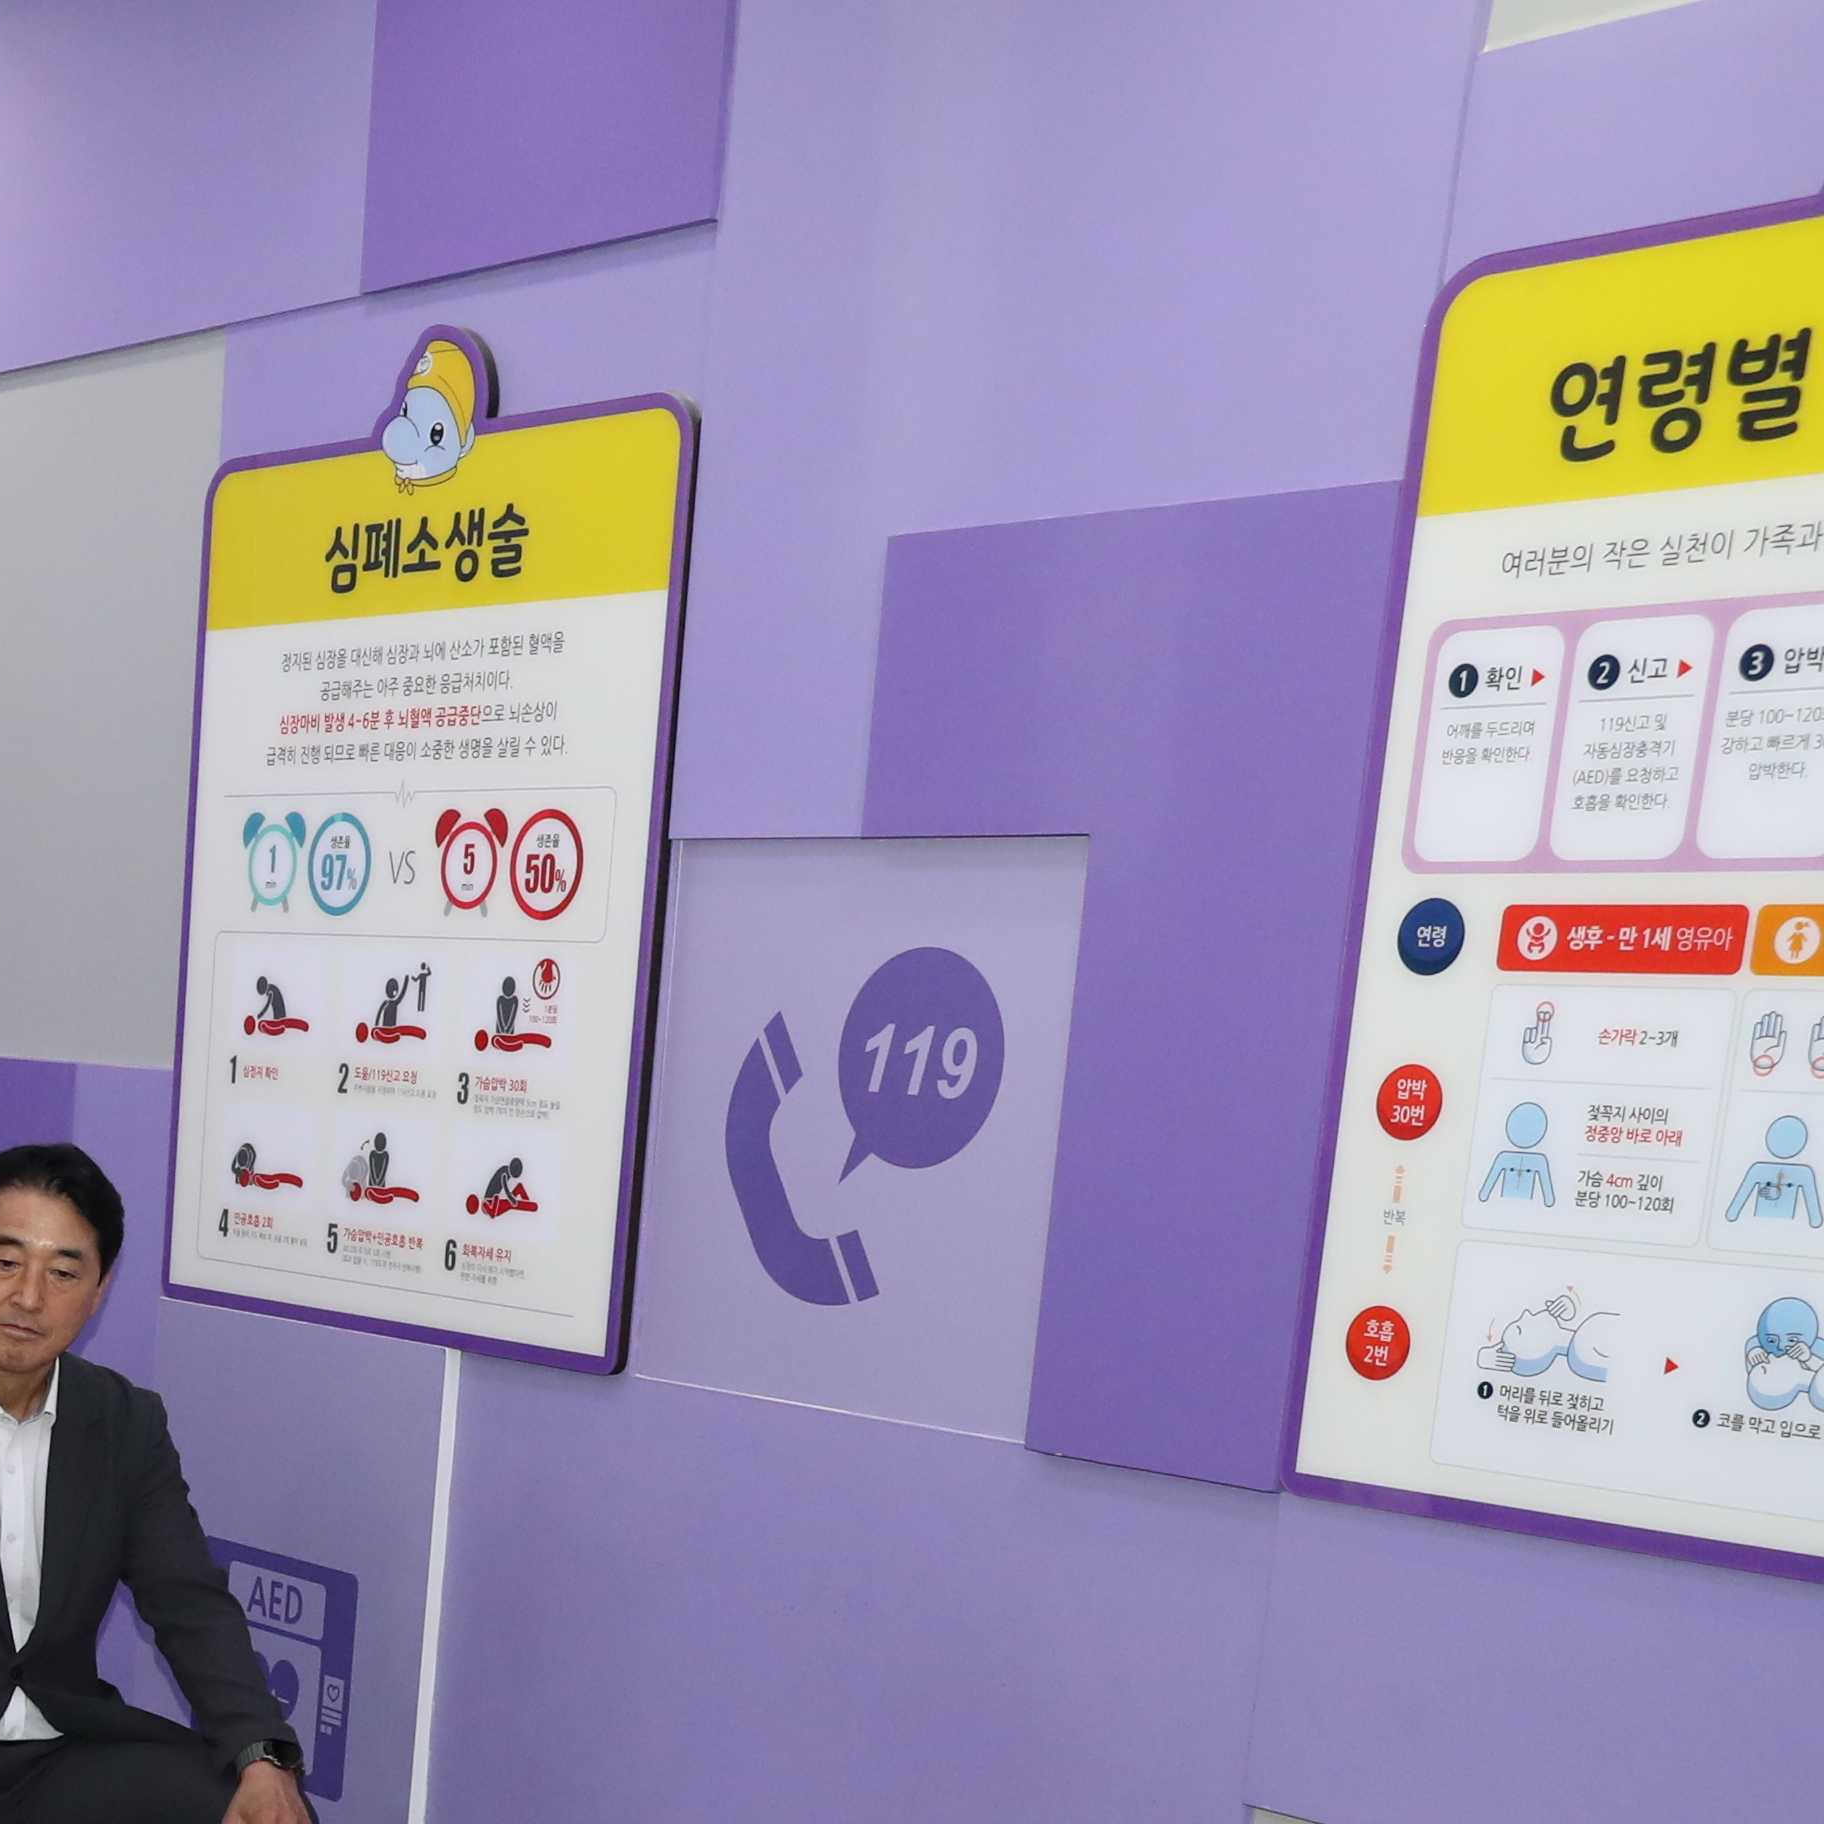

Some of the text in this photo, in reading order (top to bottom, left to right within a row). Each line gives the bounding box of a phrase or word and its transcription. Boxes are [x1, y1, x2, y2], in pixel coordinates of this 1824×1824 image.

[1550, 327, 1812, 462] 연령별
[325, 503, 529, 594] 심폐소생술
[1502, 520, 1824, 579] 여러분의 작은 실천이 가족과
[282, 631, 565, 672] 정지된 심장을 대신해 심장과 뇌에 산소가 포함된 혈액을
[1748, 651, 1765, 675] 3
[1485, 665, 1523, 691] 확인
[1596, 657, 1669, 684] 2 신고
[320, 669, 513, 701] 공급해주는 아주 중요한 응급처치이다.
[280, 700, 558, 735] 심장마비 발생 4~6분 후 뇌혈액 공급중단으로 뇌손상이
[1446, 720, 1535, 740] 어깨를 두드리며
[1600, 713, 1668, 732] 119신고 및
[1726, 709, 1754, 728] 분당
[266, 734, 568, 766] 급격히 진행 되므로 빠른 대응이 소중한 생명을 살릴 수 있다.
[1442, 745, 1533, 765] 반응을 확인한다.
[1582, 739, 1676, 760] 자동심장충격기
[1721, 736, 1763, 755] 강하고
[1767, 734, 1810, 752] 빠르게
[1572, 766, 1680, 785] (AED)를 요청하고
[1749, 761, 1808, 781] 압박한다.
[1571, 793, 1671, 812] 호흡을 확인한다.
[268, 844, 278, 874] 1
[320, 854, 357, 891] 97%
[388, 850, 416, 885] VS
[463, 843, 476, 875] 5
[524, 853, 567, 894] 50%
[1416, 924, 1447, 949] 연령
[1567, 925, 1604, 951] 생후
[1618, 926, 1637, 951] 만
[1642, 926, 1672, 951] 1세
[1676, 926, 1734, 952] 영유아
[1598, 1028, 1679, 1048] 손가락 2~3개
[229, 1055, 237, 1084] 1
[864, 1022, 978, 1100] 119
[337, 1063, 349, 1094] 2
[402, 1069, 418, 1084] 요청
[457, 1072, 469, 1104] 3
[1396, 1078, 1428, 1100] 압박
[1390, 1104, 1425, 1127] 30번
[1588, 1104, 1669, 1125] 젖꼭지 사이의
[1584, 1125, 1683, 1147] 정중앙 바로 아래
[1577, 1170, 1663, 1192] 가슴 4cm 깊이
[1574, 1190, 1675, 1214] 분당 100~120회
[218, 1209, 229, 1237] 4
[1383, 1209, 1406, 1226] 반복
[327, 1223, 338, 1254] 5
[444, 1239, 457, 1271] 6
[495, 1248, 512, 1263] 유지
[1363, 1319, 1395, 1342] 호흡
[1363, 1345, 1389, 1367] 2번
[1499, 1384, 1536, 1405] 머리를
[1538, 1389, 1563, 1407] 뒤로
[1567, 1393, 1604, 1412] 젖히고
[1497, 1404, 1614, 1435] 턱을 위로 들어올리기
[1716, 1413, 1745, 1432] 코를
[1749, 1416, 1775, 1434] 막고
[1780, 1420, 1821, 1440] 입으로
[246, 1576, 303, 1625] AED
